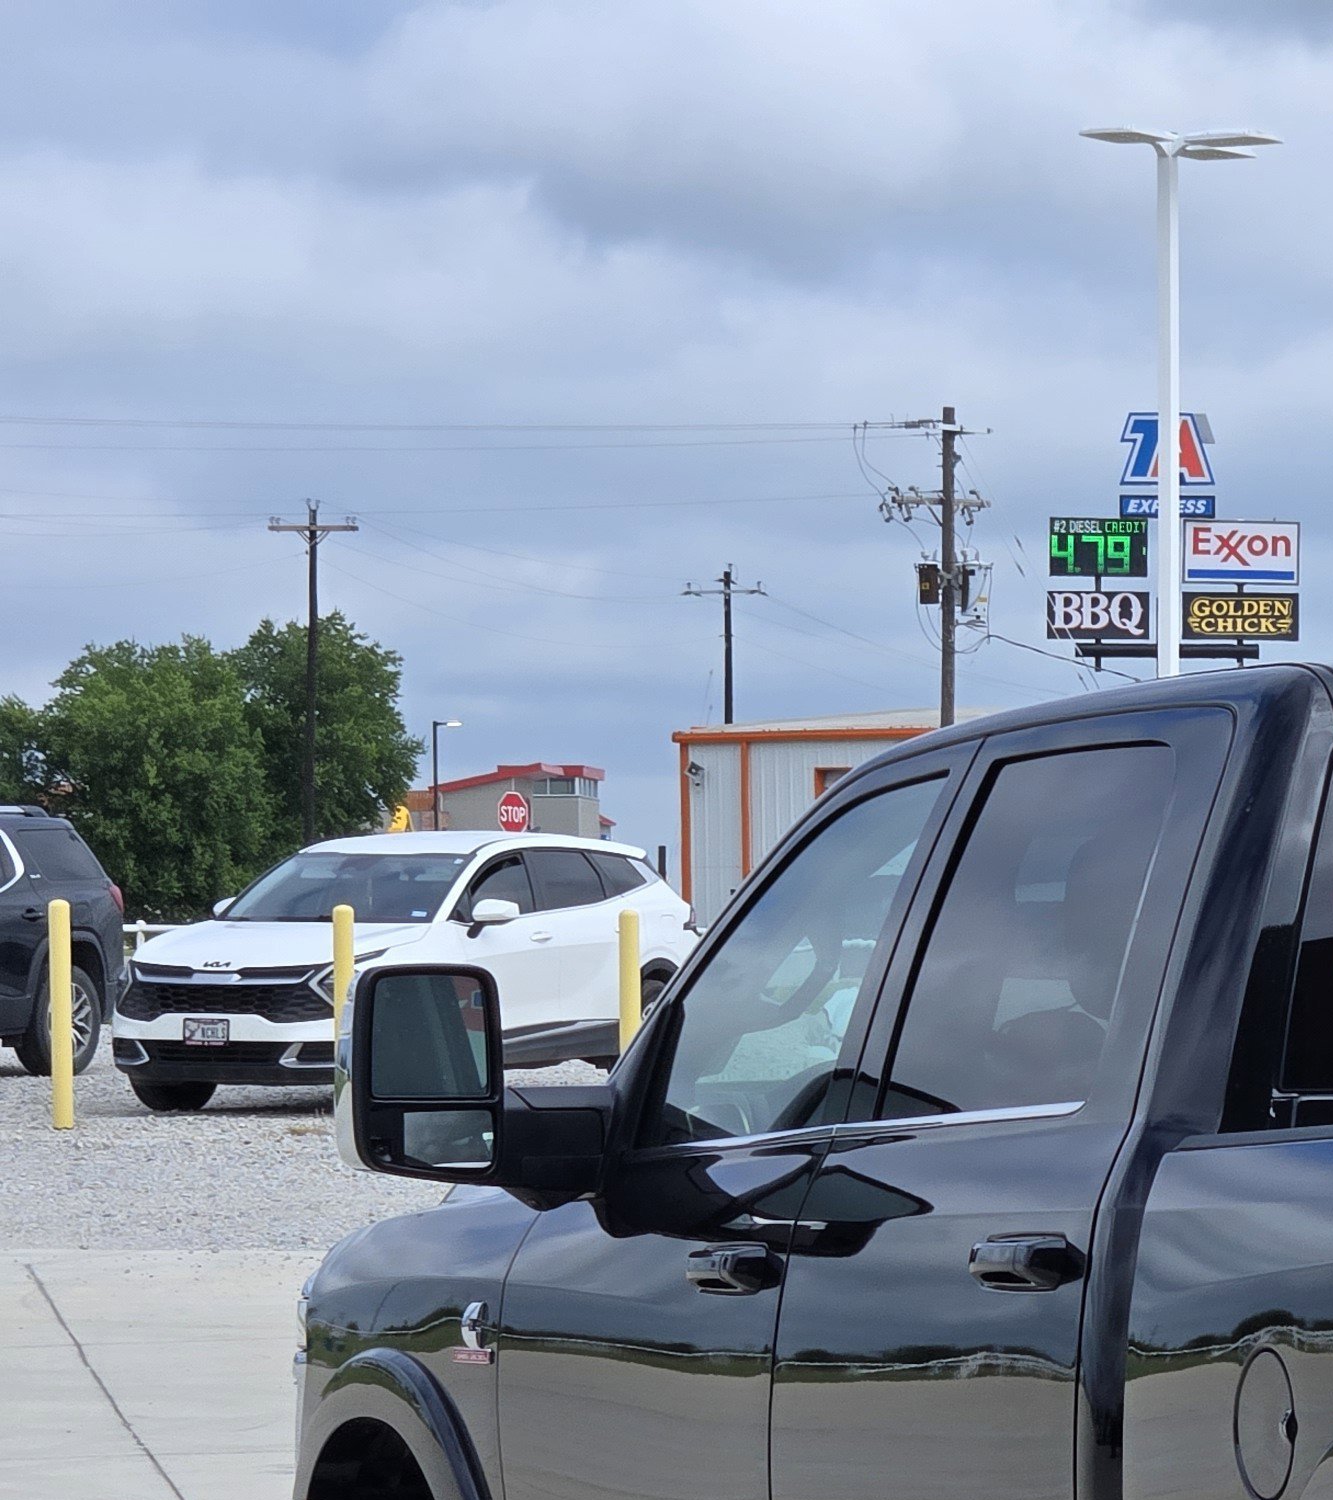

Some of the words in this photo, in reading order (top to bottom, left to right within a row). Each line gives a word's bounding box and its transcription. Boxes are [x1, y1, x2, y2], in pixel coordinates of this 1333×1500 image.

[1070, 520, 1102, 533] DIESEL
[1105, 521, 1146, 533] CREDIT
[1192, 527, 1291, 566] Exxon
[1052, 592, 1144, 635] BBQ
[1192, 600, 1290, 616] GOLDEN
[1201, 617, 1277, 632] CHICK
[500, 805, 525, 823] STOP
